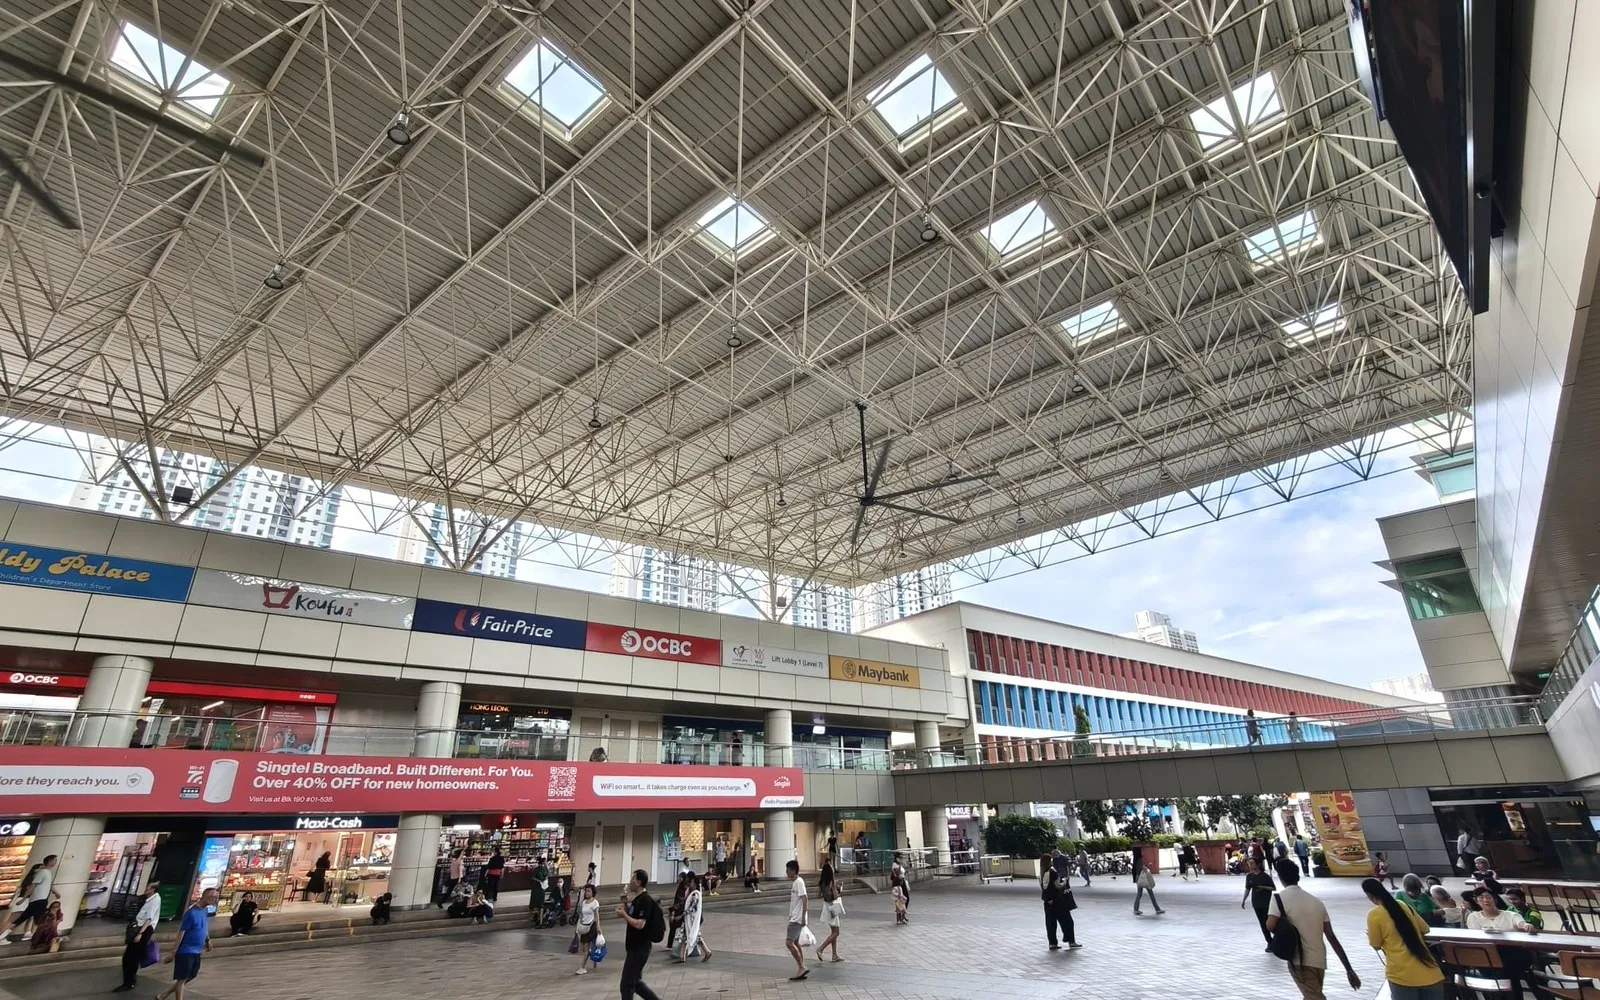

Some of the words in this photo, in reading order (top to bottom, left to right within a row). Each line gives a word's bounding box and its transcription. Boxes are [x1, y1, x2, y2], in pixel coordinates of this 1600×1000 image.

[48, 554, 151, 582] Palace
[40, 577, 87, 588] Department
[88, 582, 112, 590] Store
[295, 594, 344, 616] Koufu
[482, 615, 553, 638] FairPrice
[642, 635, 692, 657] OCBC
[771, 655, 781, 663] Lift
[782, 657, 797, 666] Lobby
[24, 674, 60, 684] OCBC
[858, 665, 910, 682] Maybank
[256, 760, 311, 776] Singtel
[312, 762, 394, 775] Broadband.
[396, 764, 427, 776] Built
[429, 764, 486, 777] Different.
[487, 765, 508, 777] For
[510, 766, 534, 777] You.
[26, 776, 55, 787] they
[56, 776, 93, 786] reach
[94, 778, 120, 787] you.
[253, 776, 291, 789] Over
[293, 777, 328, 789] 40%
[330, 777, 362, 789] OFF
[363, 778, 383, 790] for
[385, 780, 414, 790] new
[416, 779, 500, 790] homeowners.
[668, 784, 687, 792] charge
[717, 784, 742, 792] recharge.
[295, 816, 362, 829] Maxi-Cash
